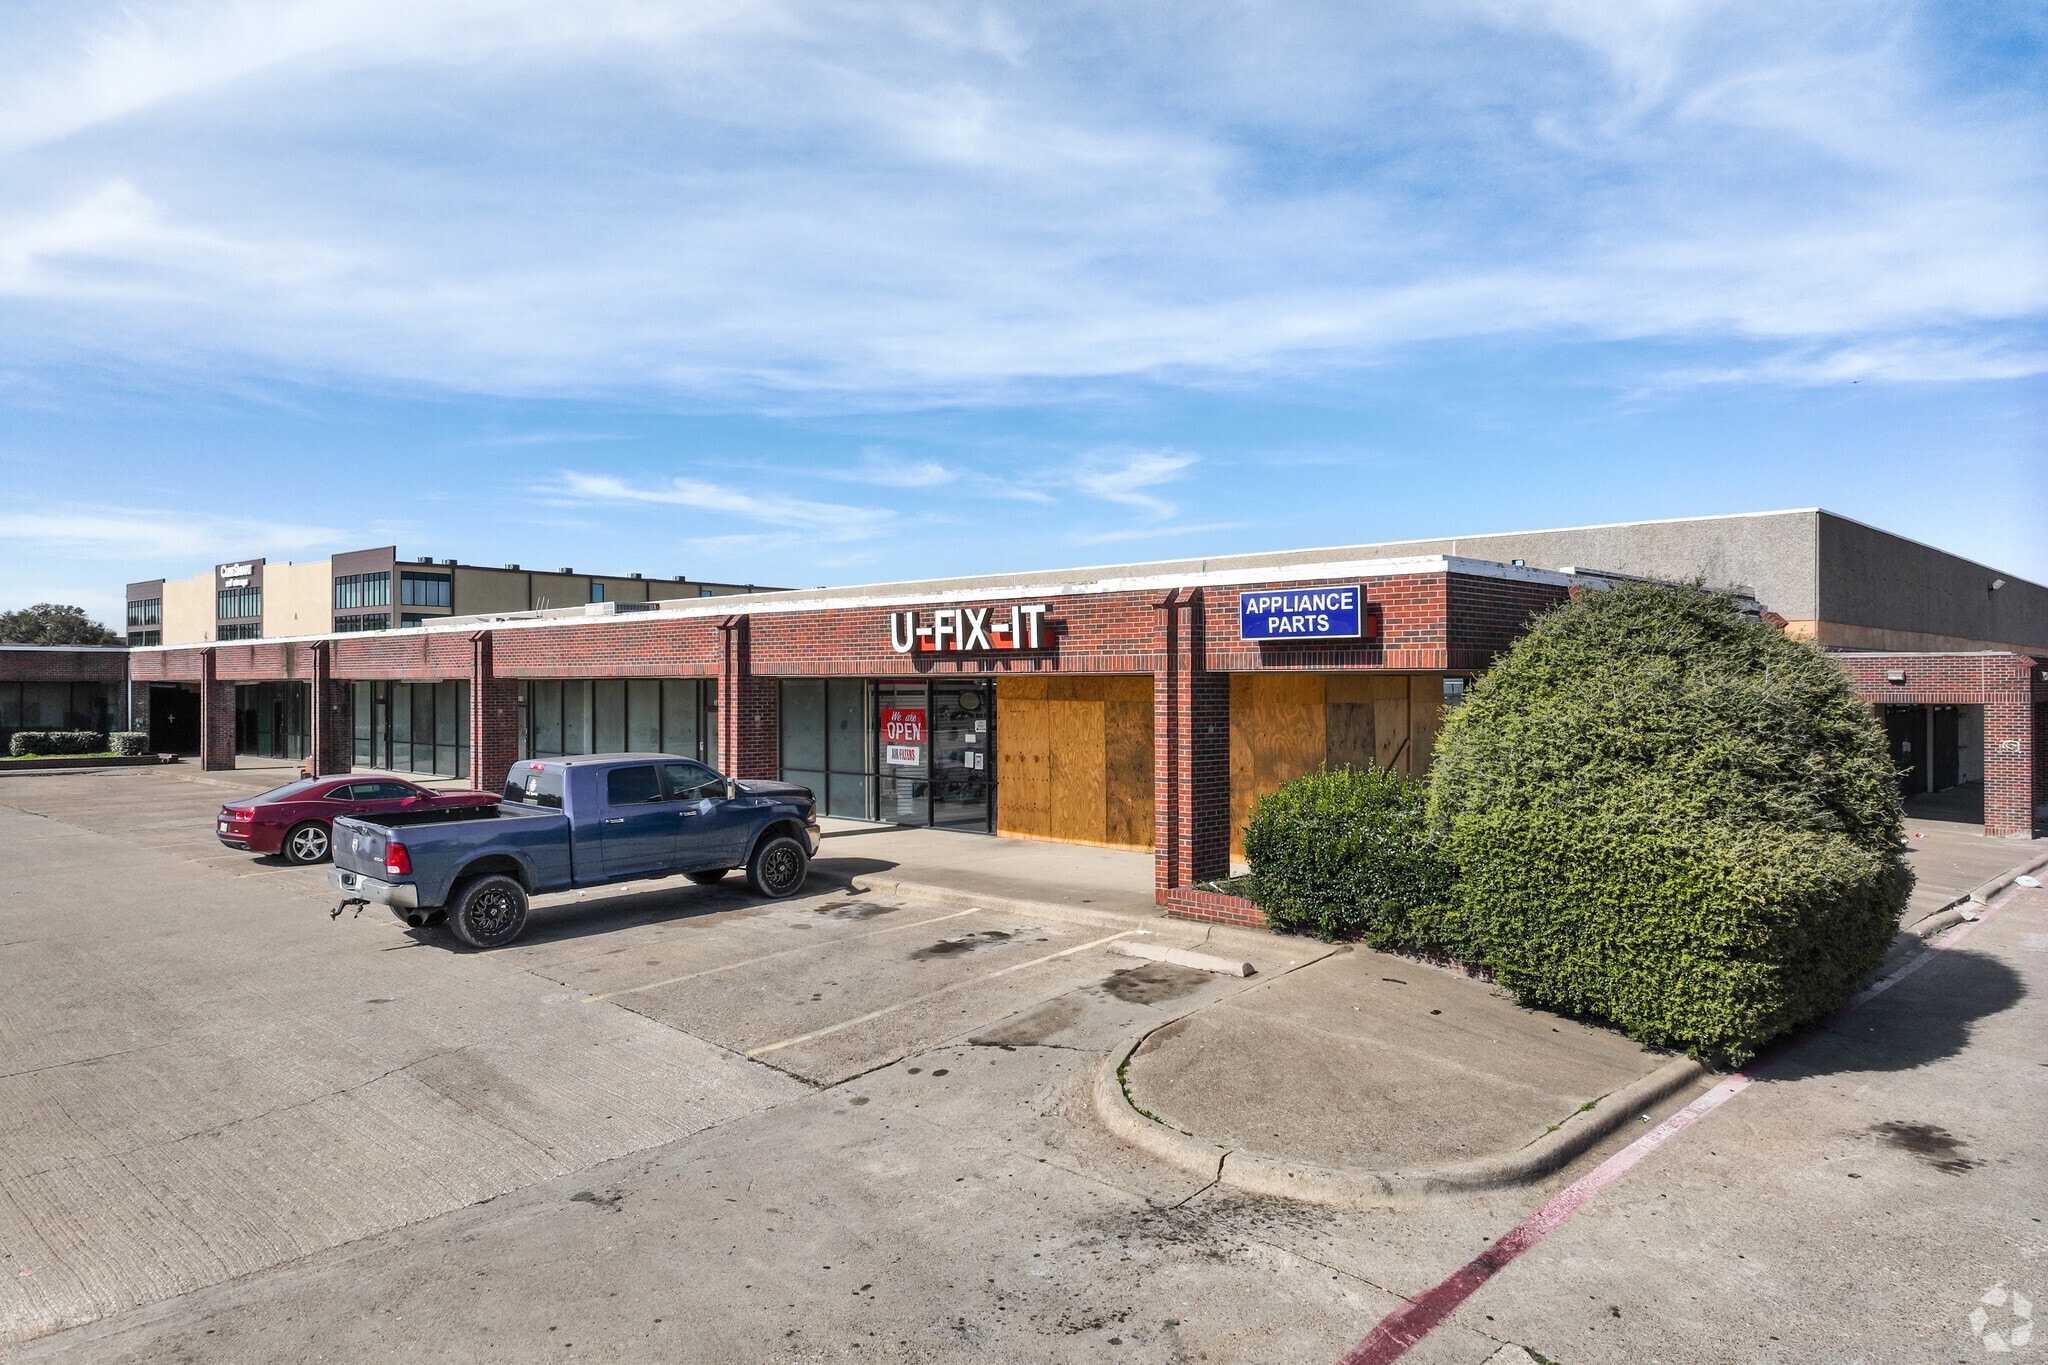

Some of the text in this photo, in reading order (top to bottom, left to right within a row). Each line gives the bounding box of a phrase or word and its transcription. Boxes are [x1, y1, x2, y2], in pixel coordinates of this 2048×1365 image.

[1245, 592, 1354, 615] APPLIANCE
[891, 604, 1046, 653] U-FIX-IT
[1268, 614, 1330, 634] PARTS
[892, 712, 902, 721] We
[887, 722, 921, 740] OPEN
